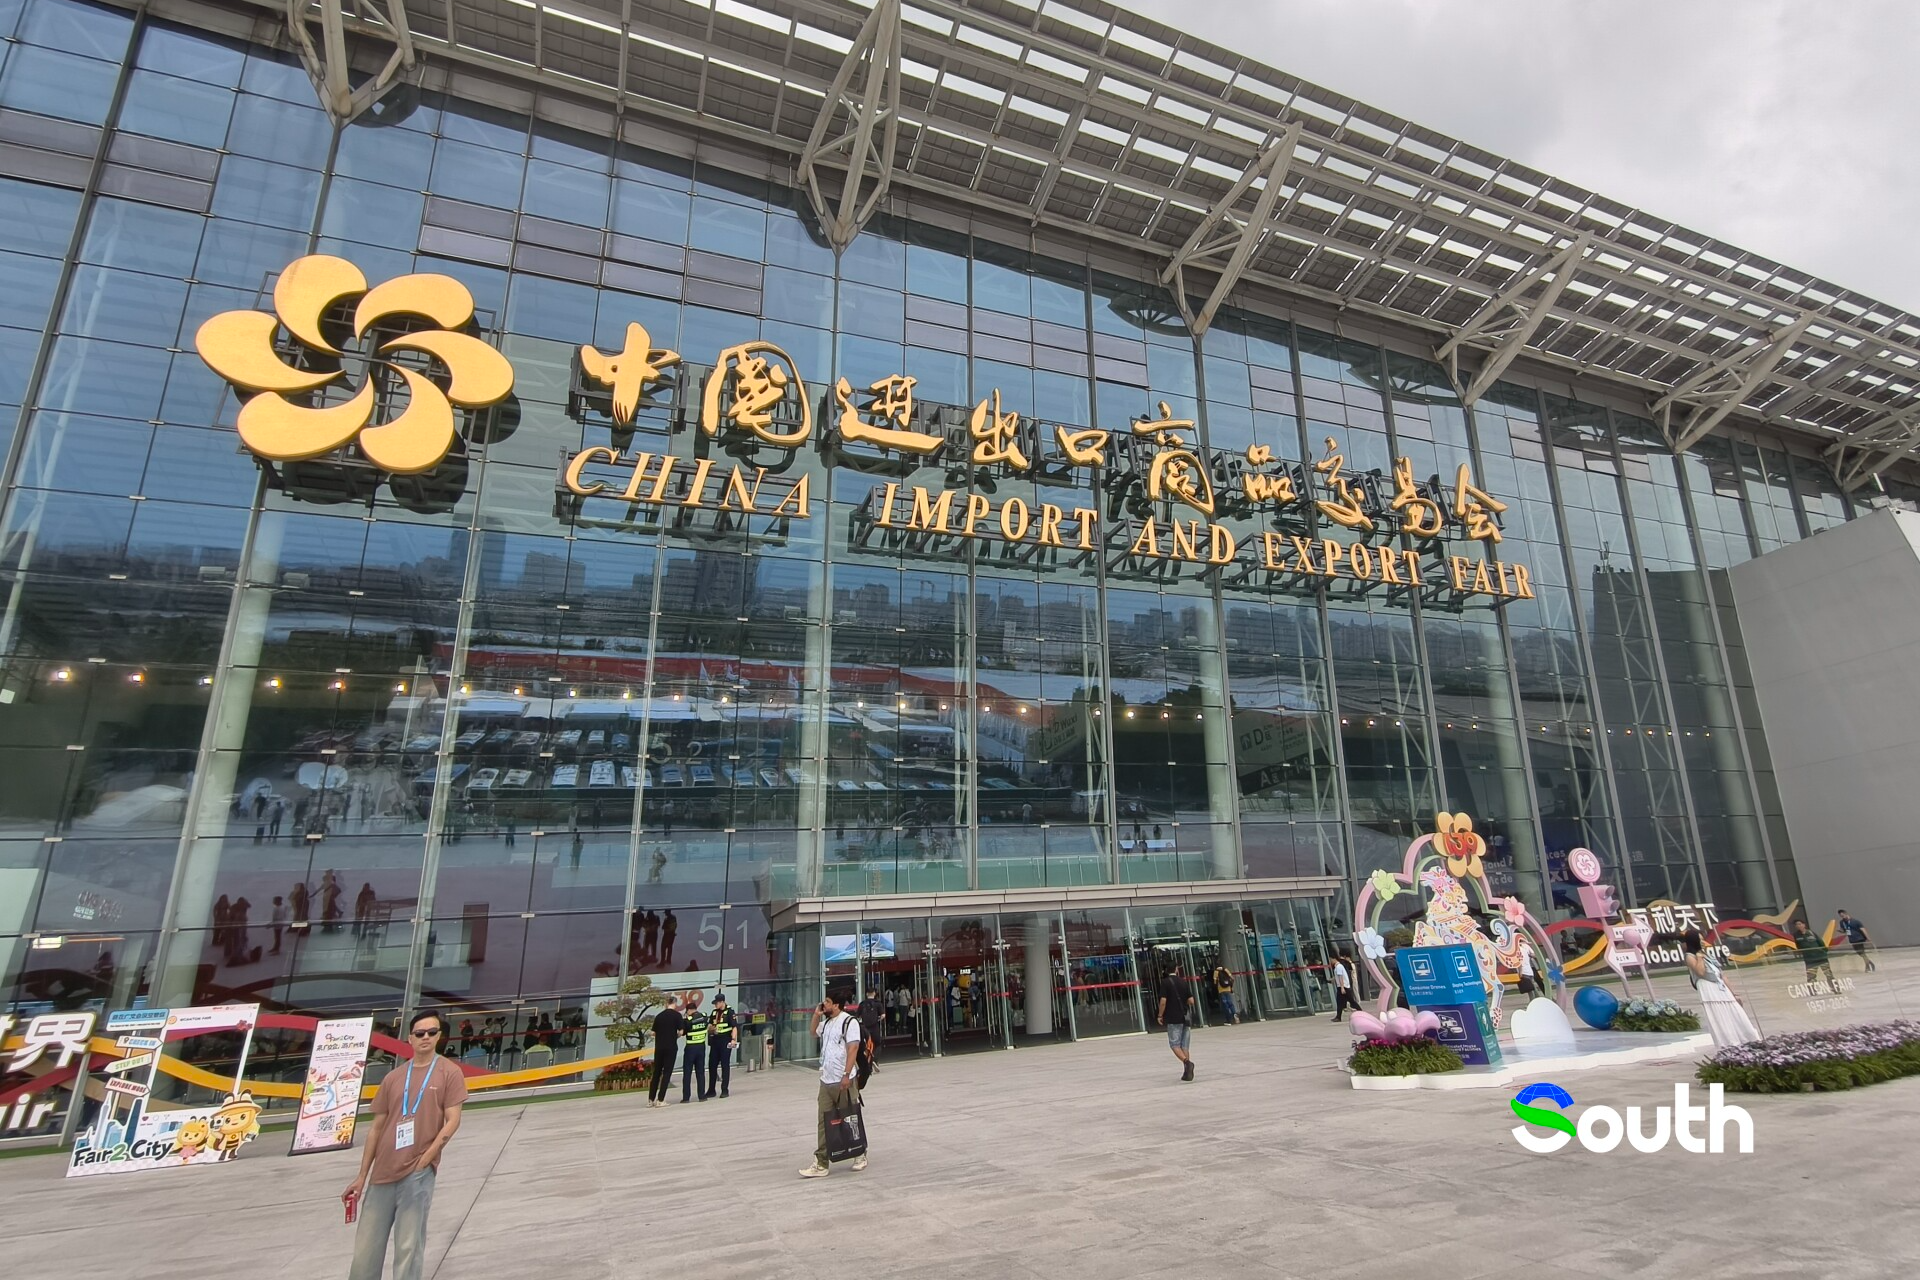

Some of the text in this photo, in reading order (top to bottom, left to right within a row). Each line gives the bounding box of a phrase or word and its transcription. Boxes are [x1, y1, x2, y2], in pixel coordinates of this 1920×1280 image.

[564, 445, 1536, 599] CHINA IMPORT AND EXPORT FAIR
[650, 732, 703, 765] 5.2
[698, 912, 748, 952] 5.1
[1640, 944, 1685, 964] lobal
[1788, 977, 1855, 999] CANTON FAIR
[115, 1056, 144, 1070] STEP OUT
[110, 1080, 147, 1094] EXPLORE MORE
[0, 1093, 56, 1130] ir
